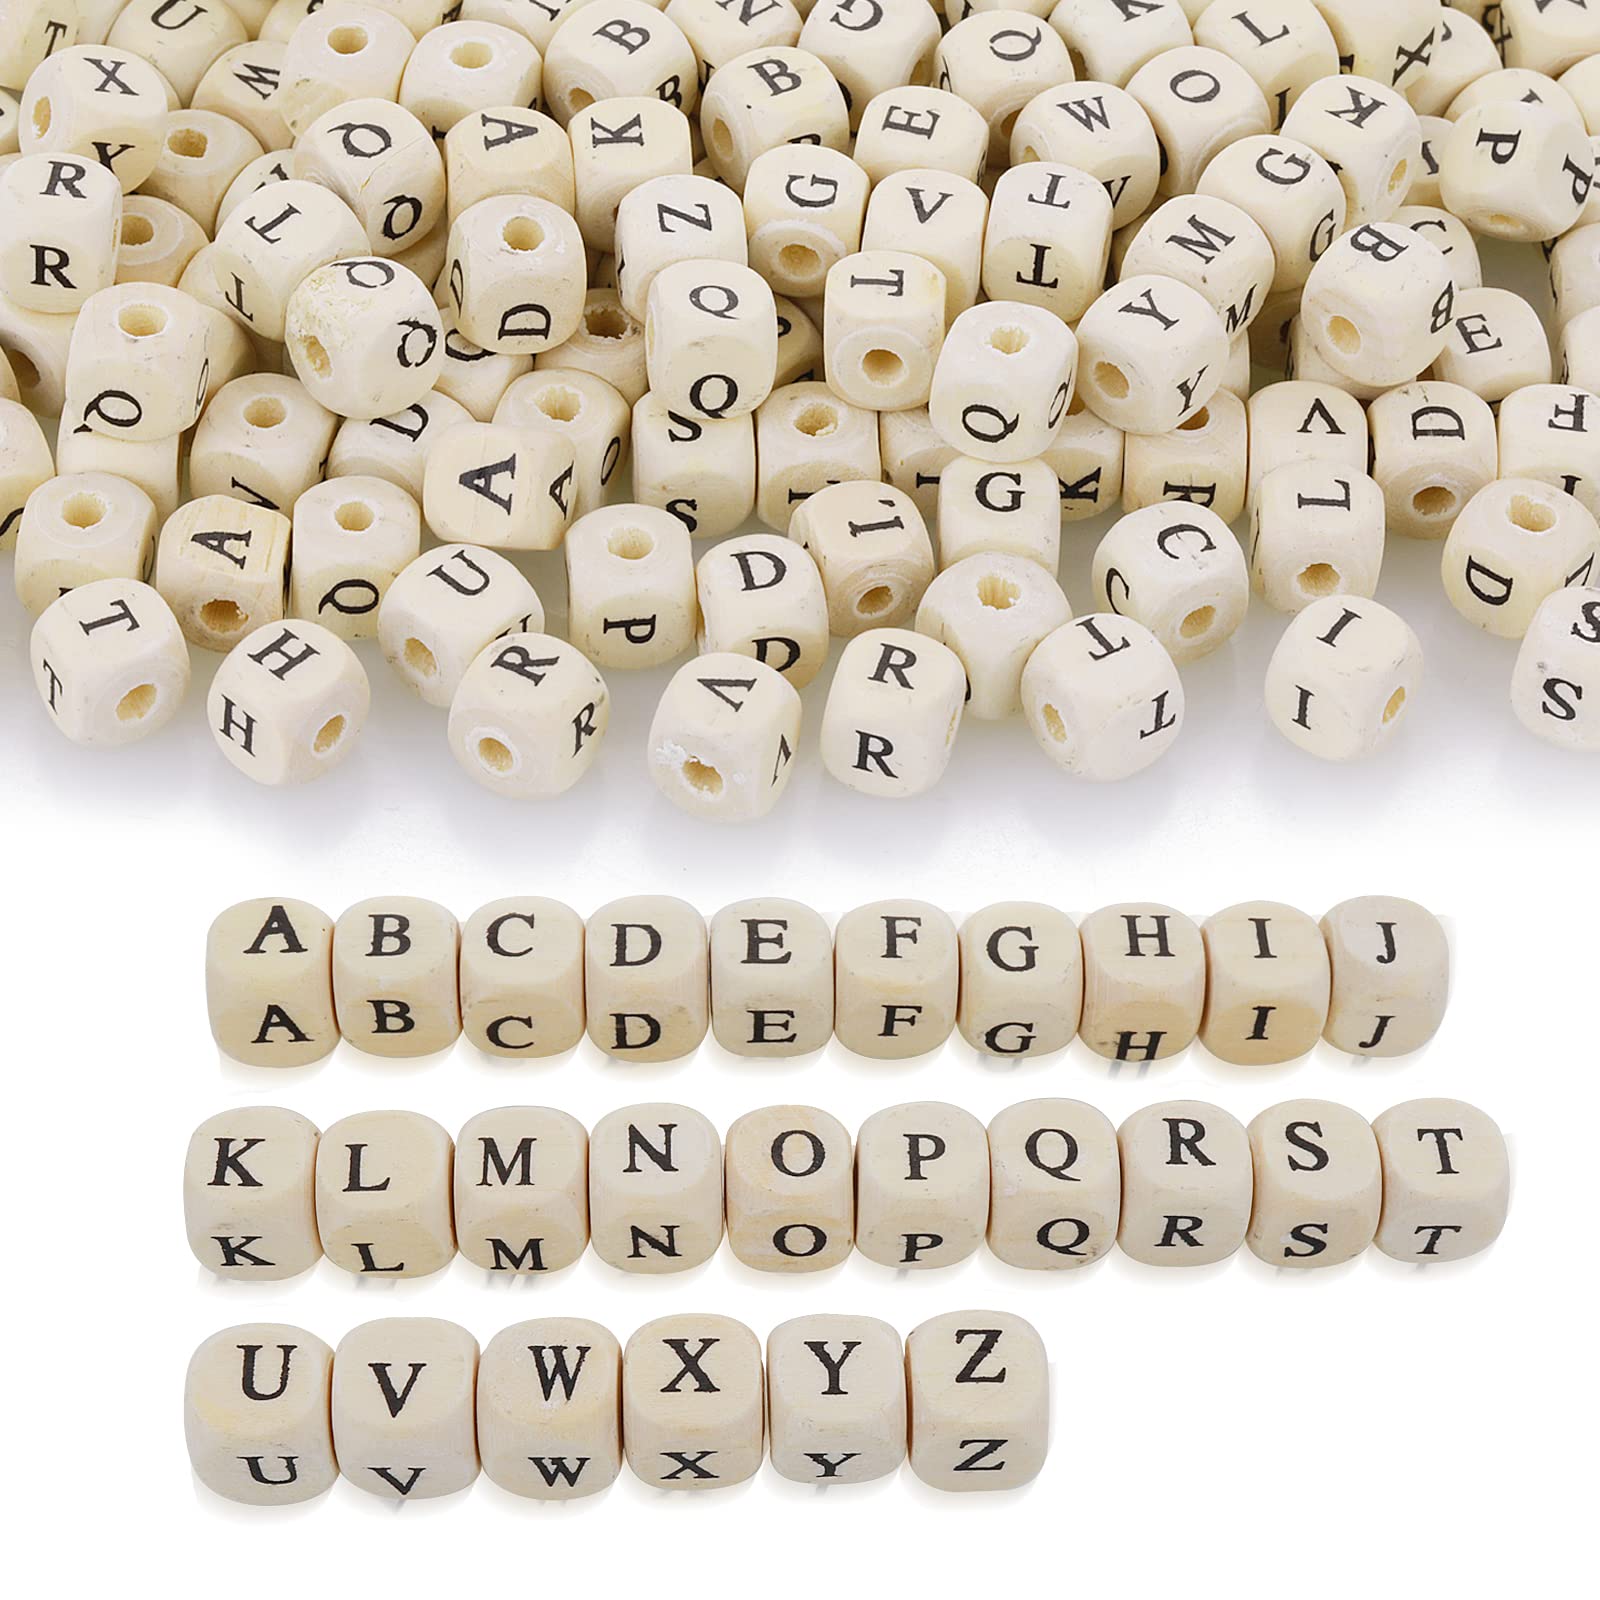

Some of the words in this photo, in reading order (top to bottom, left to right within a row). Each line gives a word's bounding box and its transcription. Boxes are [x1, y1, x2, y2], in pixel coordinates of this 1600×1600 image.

[150, 0, 208, 30] U
[1231, 12, 1290, 46] L
[44, 20, 67, 59] T
[593, 20, 650, 54] B
[989, 27, 1042, 62] Q
[1392, 27, 1436, 87] X
[84, 57, 139, 96] X
[747, 59, 802, 96] B
[882, 105, 940, 140] E
[1057, 96, 1110, 132] W
[1327, 87, 1386, 129] K
[327, 122, 392, 158] Q
[481, 113, 538, 151] A
[590, 114, 645, 149] K
[1475, 127, 1522, 165] P
[39, 160, 87, 199] R
[1255, 148, 1311, 185] G
[1562, 153, 1594, 206] P
[785, 174, 838, 208] G
[906, 187, 952, 224] V
[1028, 173, 1070, 209] T
[244, 203, 301, 244] T
[1165, 214, 1236, 265] M
[1350, 224, 1409, 262] B
[29, 244, 77, 290] R
[332, 261, 395, 289] Q
[850, 269, 904, 297] T
[1015, 243, 1059, 289] T
[224, 272, 254, 323] T
[689, 285, 739, 319] Q
[1118, 288, 1180, 331] Y
[1430, 279, 1454, 335] B
[497, 303, 552, 341] D
[1455, 314, 1503, 354] E
[83, 389, 143, 428] Q
[689, 374, 739, 420] Q
[1177, 364, 1209, 418] Y
[961, 404, 1020, 444] Q
[1411, 406, 1465, 441] D
[1547, 392, 1590, 433] F
[458, 453, 516, 516] A
[548, 459, 575, 521] A
[974, 471, 1026, 513] G
[1297, 479, 1351, 511] L
[190, 530, 252, 570] A
[1157, 523, 1217, 560] C
[426, 549, 490, 596] U
[730, 551, 787, 592] D
[1105, 567, 1130, 616] C
[1465, 555, 1514, 606] D
[318, 578, 380, 615] Q
[79, 599, 140, 636] T
[602, 614, 657, 644] P
[1316, 608, 1362, 648] I
[247, 628, 320, 681] H
[751, 636, 801, 673] D
[1076, 617, 1131, 661] T
[490, 645, 560, 687] R
[868, 643, 917, 690] R
[42, 658, 63, 716] T
[1292, 684, 1314, 730] I
[1542, 677, 1583, 721] S
[220, 695, 256, 756] H
[572, 701, 598, 759] R
[1140, 690, 1176, 739] T
[852, 730, 899, 779] R
[243, 905, 308, 954] A
[365, 914, 411, 957] B
[486, 913, 535, 957] C
[609, 923, 662, 967] D
[740, 918, 792, 964] E
[880, 916, 922, 959] F
[986, 926, 1039, 972] G
[1121, 914, 1176, 957] H
[1247, 918, 1277, 959] I
[1376, 922, 1397, 964] J
[250, 1004, 315, 1044] A
[366, 999, 416, 1034] B
[485, 1015, 534, 1050] C
[609, 1012, 662, 1050] D
[746, 1009, 797, 1044] E
[877, 1004, 923, 1037] F
[984, 1022, 1037, 1054] G
[1115, 1030, 1168, 1062] H
[1245, 1005, 1277, 1041] I
[1358, 1015, 1395, 1049] J
[207, 1137, 266, 1187] K
[342, 1143, 391, 1193] L
[476, 1137, 537, 1187] M
[622, 1123, 679, 1173] N
[770, 1129, 826, 1177] O
[902, 1133, 946, 1181] P
[1024, 1128, 1081, 1182] Q
[1162, 1117, 1217, 1167] R
[1285, 1121, 1329, 1172] S
[1417, 1128, 1463, 1175] T
[210, 1235, 276, 1267] K
[350, 1242, 405, 1273] L
[485, 1237, 549, 1271] M
[627, 1225, 683, 1259] N
[772, 1223, 828, 1257] O
[899, 1233, 944, 1263] P
[1036, 1217, 1090, 1256] Q
[1153, 1215, 1204, 1248] R
[1283, 1223, 1329, 1258] S
[1414, 1225, 1463, 1255] T
[236, 1344, 298, 1401] U
[367, 1362, 427, 1418] V
[527, 1345, 592, 1402] W
[659, 1338, 721, 1394] X
[803, 1341, 862, 1396] Y
[955, 1329, 1006, 1384] Z
[236, 1456, 299, 1486] U
[367, 1467, 427, 1496] V
[527, 1456, 591, 1488] W
[659, 1450, 720, 1480] X
[803, 1452, 861, 1478] Y
[953, 1439, 1009, 1472] Z
